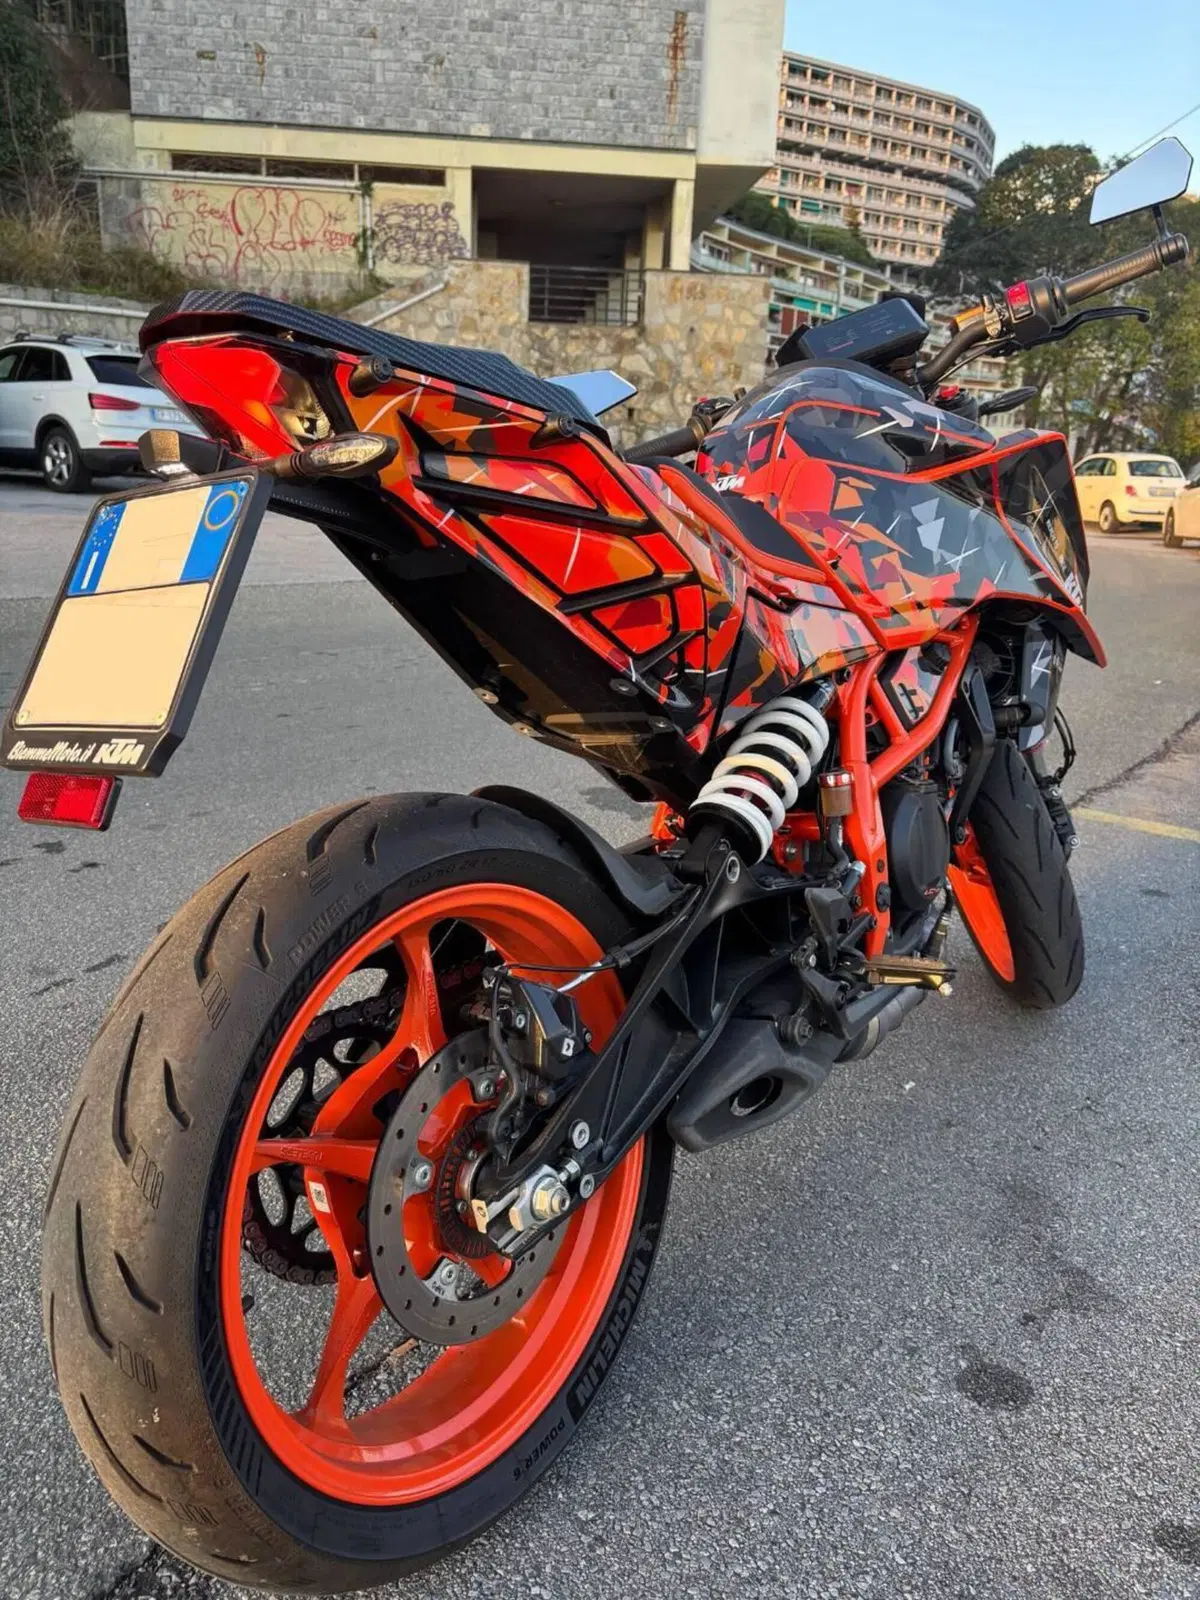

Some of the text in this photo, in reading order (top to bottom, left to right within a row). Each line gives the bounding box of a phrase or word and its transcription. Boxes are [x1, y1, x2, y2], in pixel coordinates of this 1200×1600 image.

[92, 738, 146, 765] KTM
[574, 1258, 647, 1408] MICHELIN
[512, 1416, 566, 1481] POWER 6
